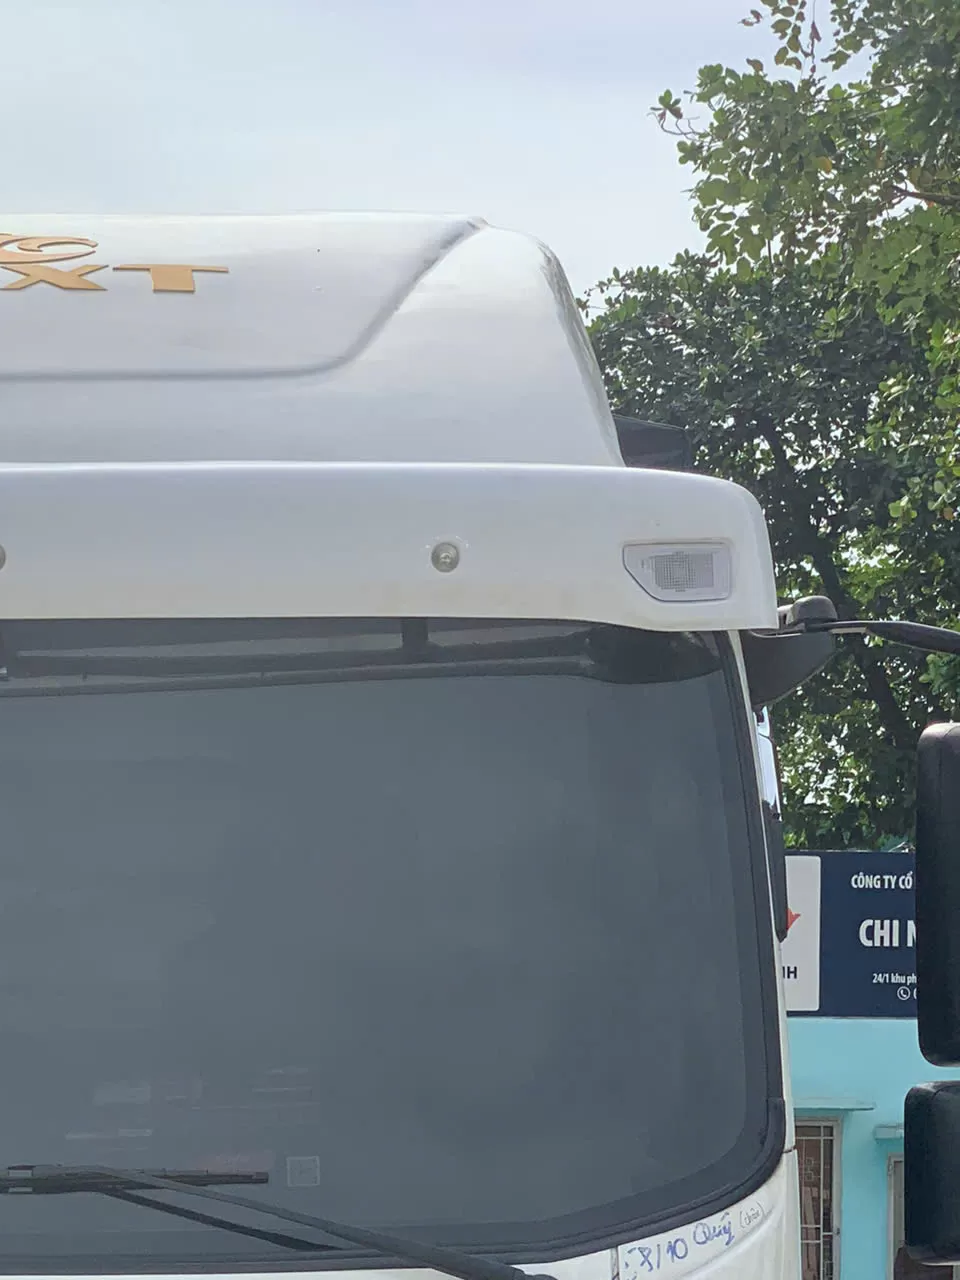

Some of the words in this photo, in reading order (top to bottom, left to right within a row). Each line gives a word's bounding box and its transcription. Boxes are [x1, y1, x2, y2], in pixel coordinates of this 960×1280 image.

[850, 871, 881, 889] CÔNG
[883, 875, 897, 889] TY
[858, 918, 900, 948] CHI
[872, 972, 890, 984] 24/1
[891, 972, 906, 984] khu
